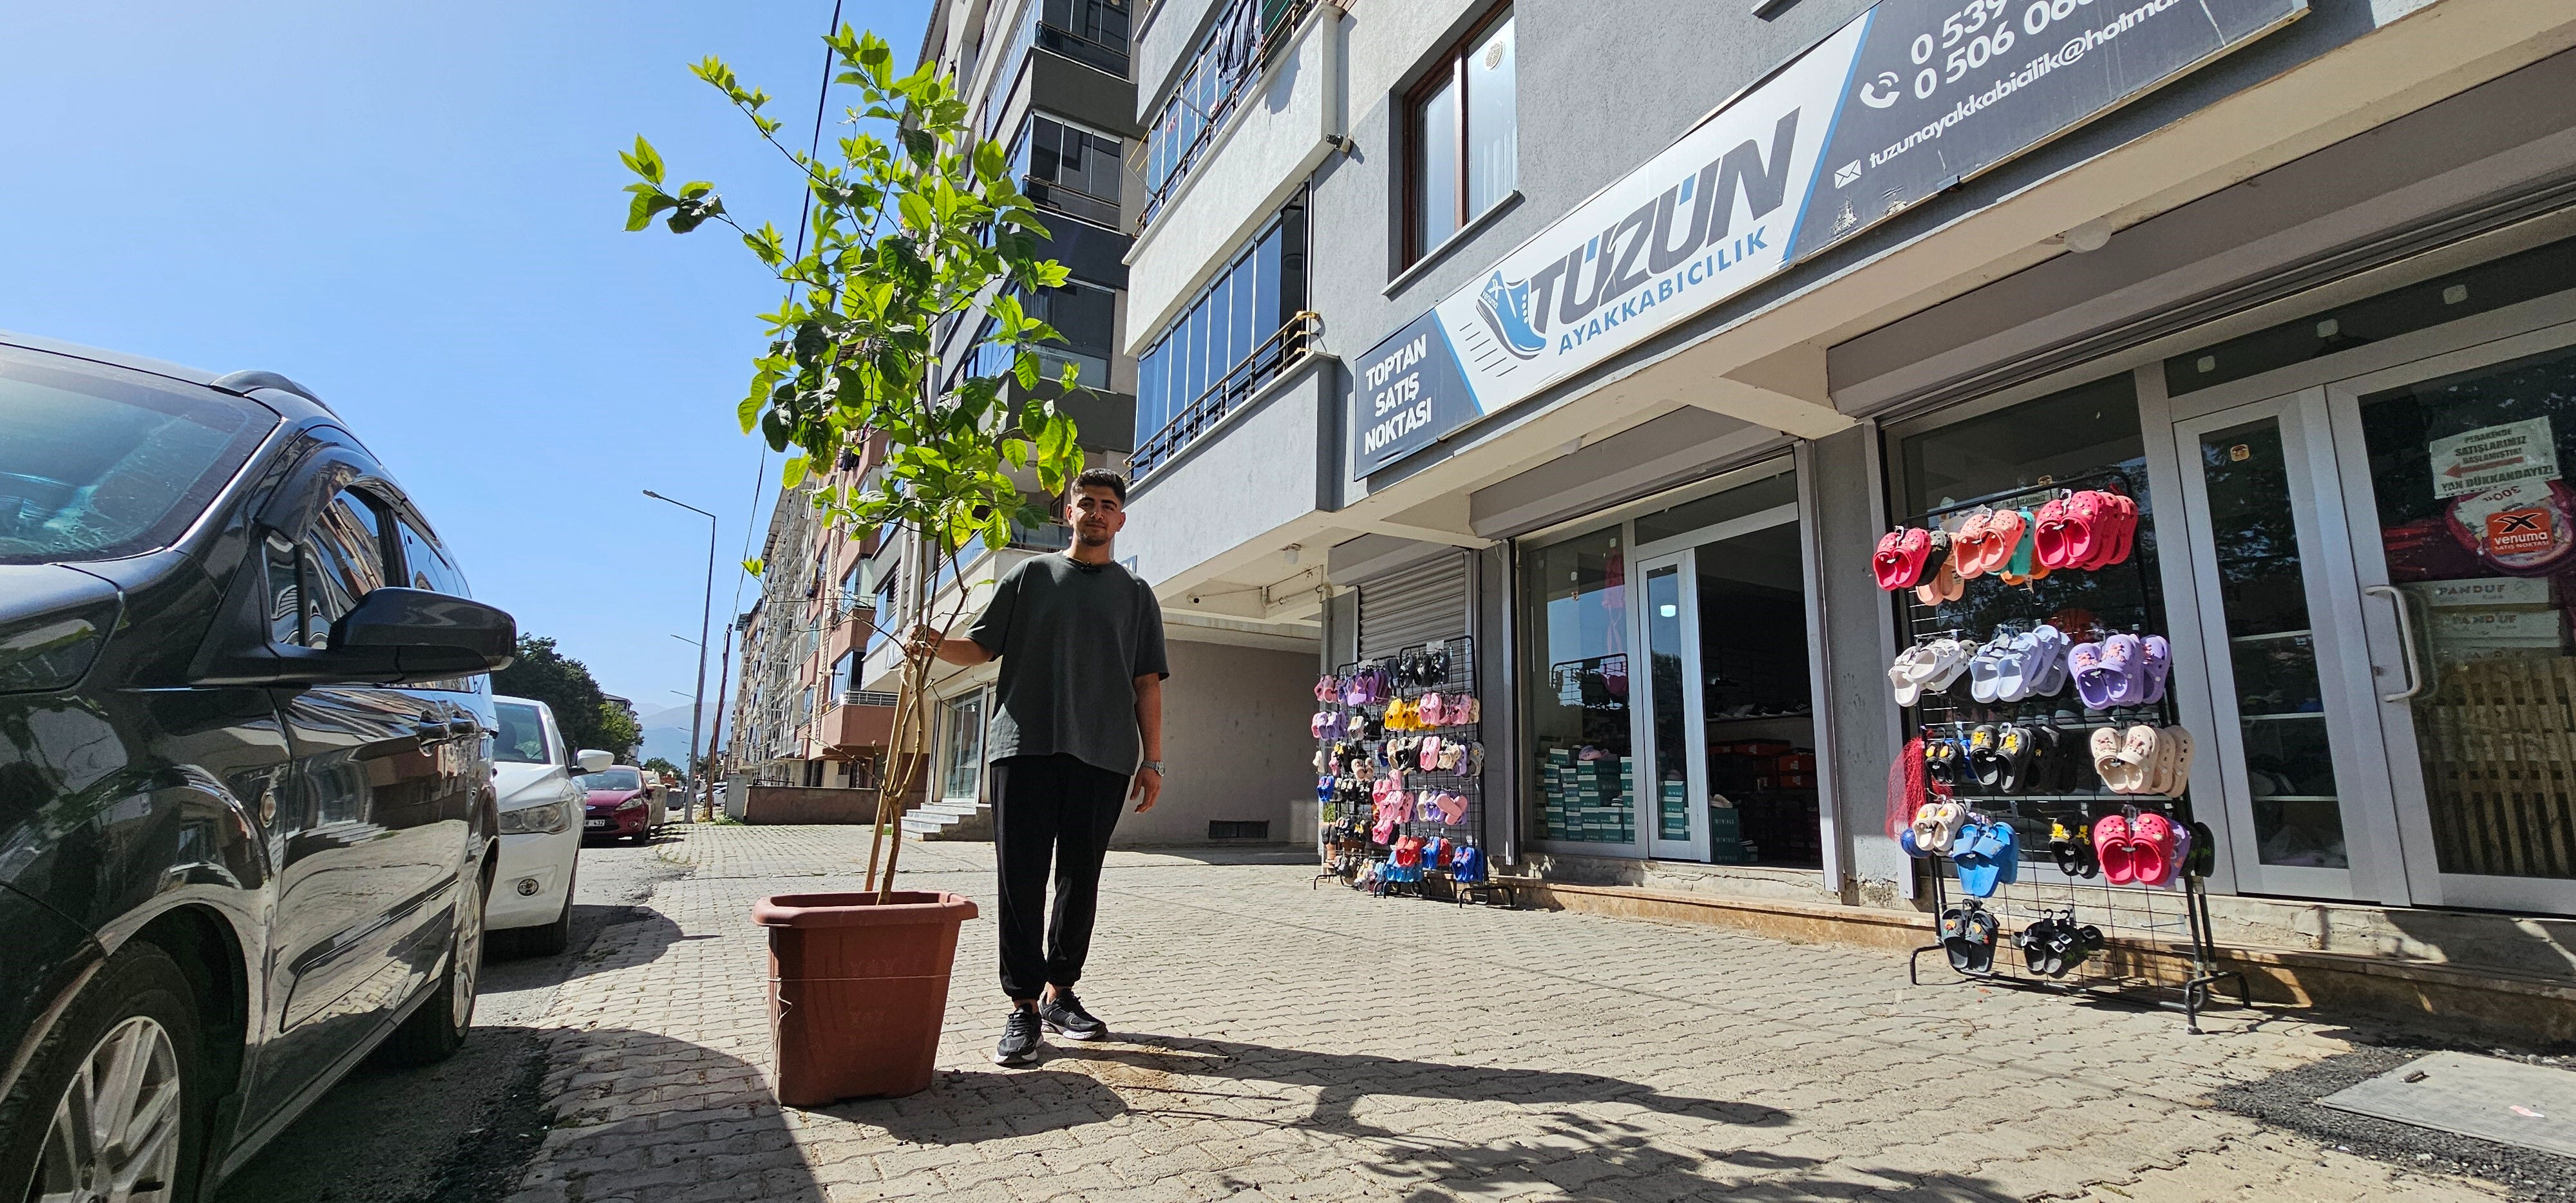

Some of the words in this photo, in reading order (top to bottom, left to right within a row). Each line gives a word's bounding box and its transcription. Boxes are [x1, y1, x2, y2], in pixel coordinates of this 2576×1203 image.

[1911, 33, 1934, 65] 0
[1915, 68, 1937, 99] 0
[1946, 21, 2015, 84] 506
[2024, 0, 2094, 35] 06
[1870, 0, 2180, 168] tuzunayakkabicilik@hotma
[1530, 106, 1801, 334] TÜZÜN
[1558, 225, 1768, 356] AYAKKABICILIK
[1366, 334, 1426, 392] TOPTAN
[1375, 372, 1419, 417] SATIŞ
[1365, 397, 1432, 455] NOKTASI
[2494, 531, 2548, 545] venuma
